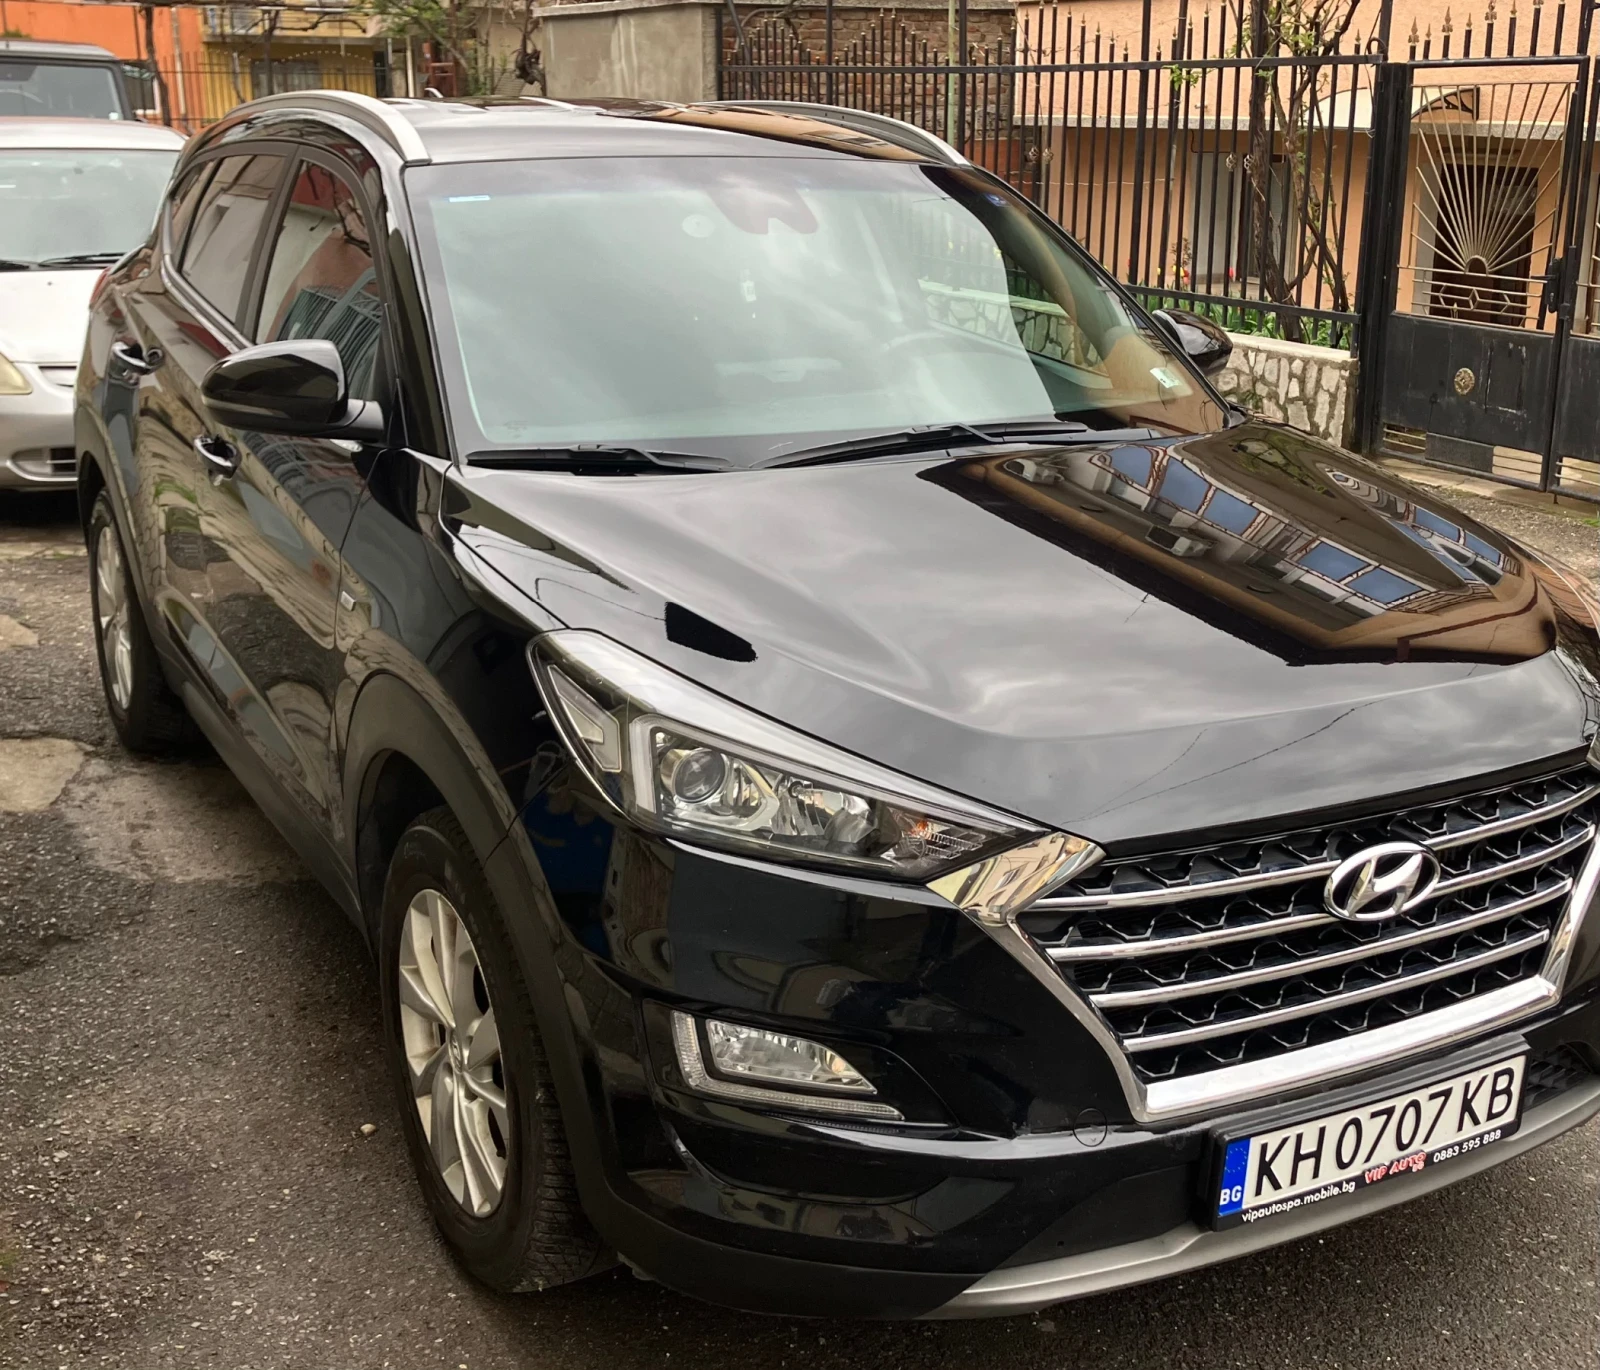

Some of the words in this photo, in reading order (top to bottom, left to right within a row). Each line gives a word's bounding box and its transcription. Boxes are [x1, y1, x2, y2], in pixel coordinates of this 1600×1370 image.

[1433, 1146, 1459, 1163] 0883
[1461, 1139, 1480, 1153] 595
[1483, 1129, 1501, 1144] 888
[1365, 1166, 1388, 1184] VIP
[1389, 1152, 1427, 1175] AUTO
[1219, 1186, 1242, 1205] BG
[1242, 1181, 1356, 1222] vipautospa.mobile.bg
